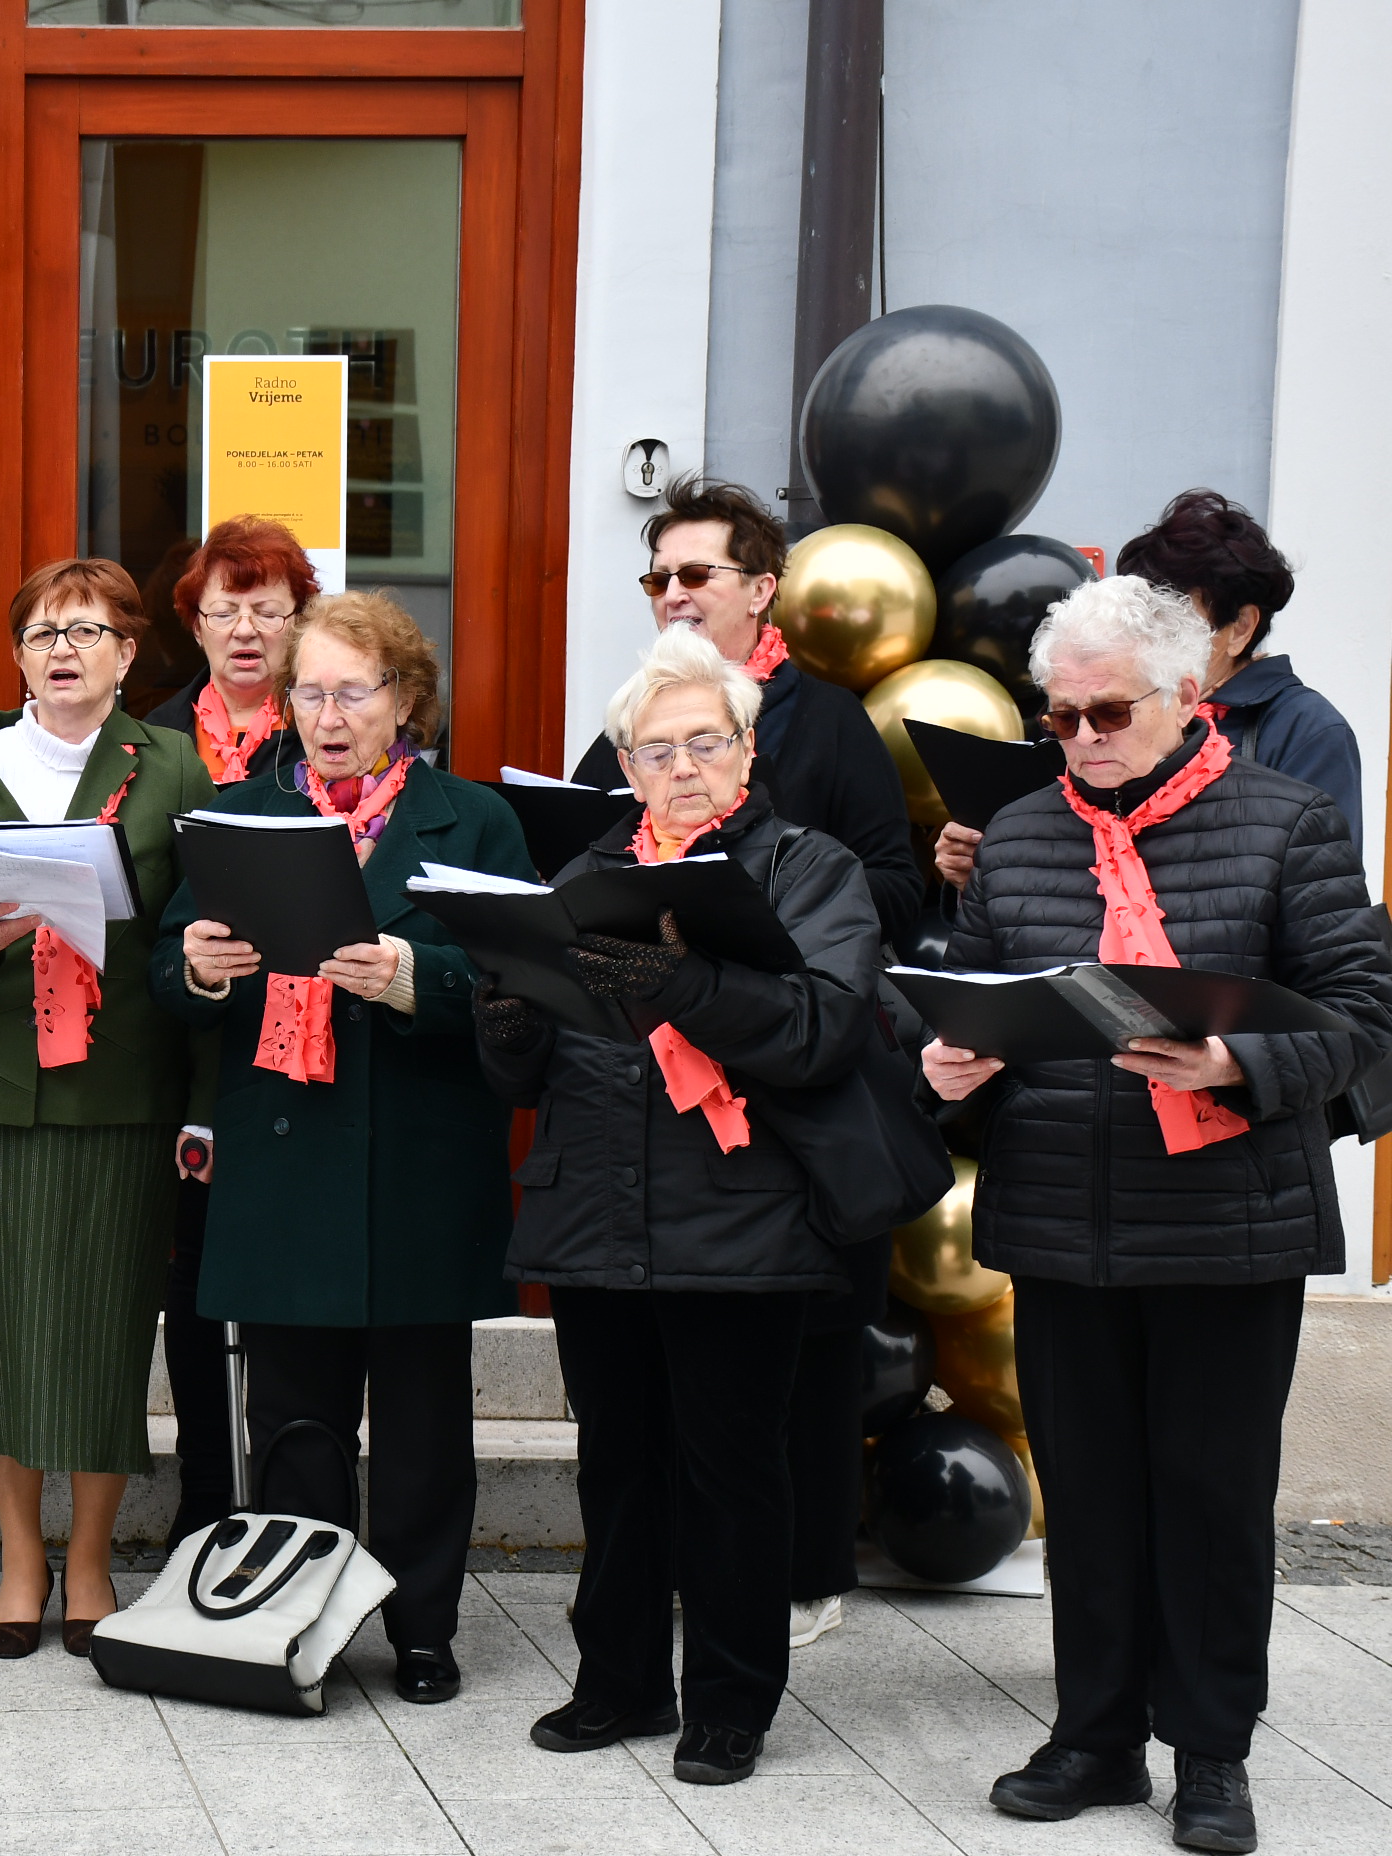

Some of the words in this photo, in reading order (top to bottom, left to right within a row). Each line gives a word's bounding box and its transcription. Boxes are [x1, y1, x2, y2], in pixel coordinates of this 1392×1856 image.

[254, 376, 297, 389] Radno
[248, 390, 303, 407] Vrijeme
[226, 450, 289, 458] PONEDJELJAK
[296, 450, 324, 458] PETAK
[237, 460, 257, 468] 8.00
[267, 460, 291, 468] 16.00
[292, 460, 313, 468] SATI
